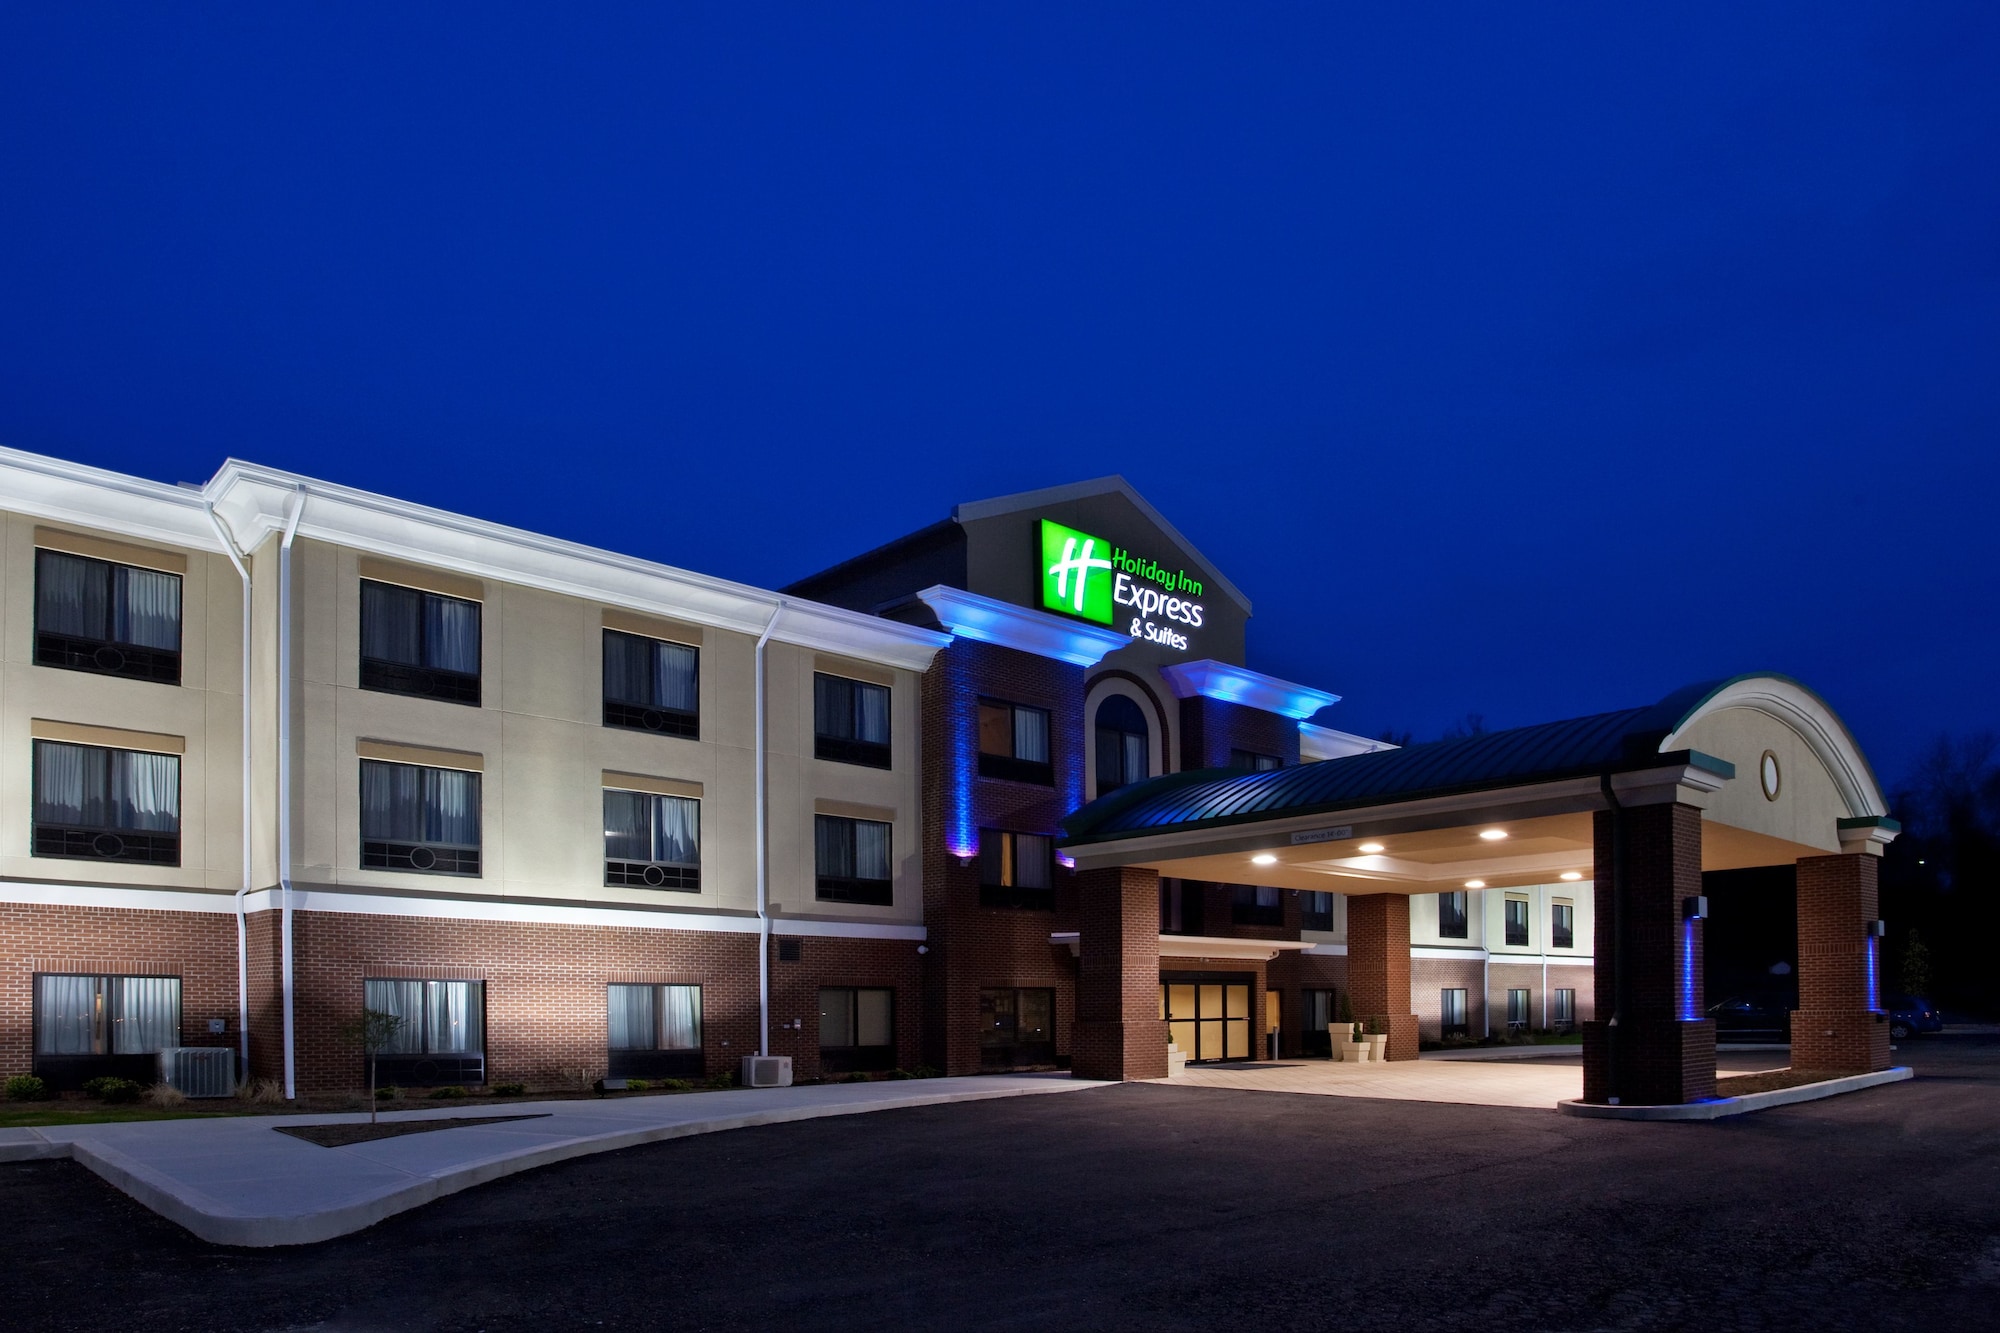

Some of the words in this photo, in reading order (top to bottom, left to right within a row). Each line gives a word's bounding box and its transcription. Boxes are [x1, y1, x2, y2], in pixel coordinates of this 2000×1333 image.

[1112, 547, 1177, 592] Holiday
[1177, 569, 1203, 597] Inn
[1113, 572, 1204, 628] Express
[1129, 617, 1142, 638] &
[1144, 621, 1188, 651] Suites
